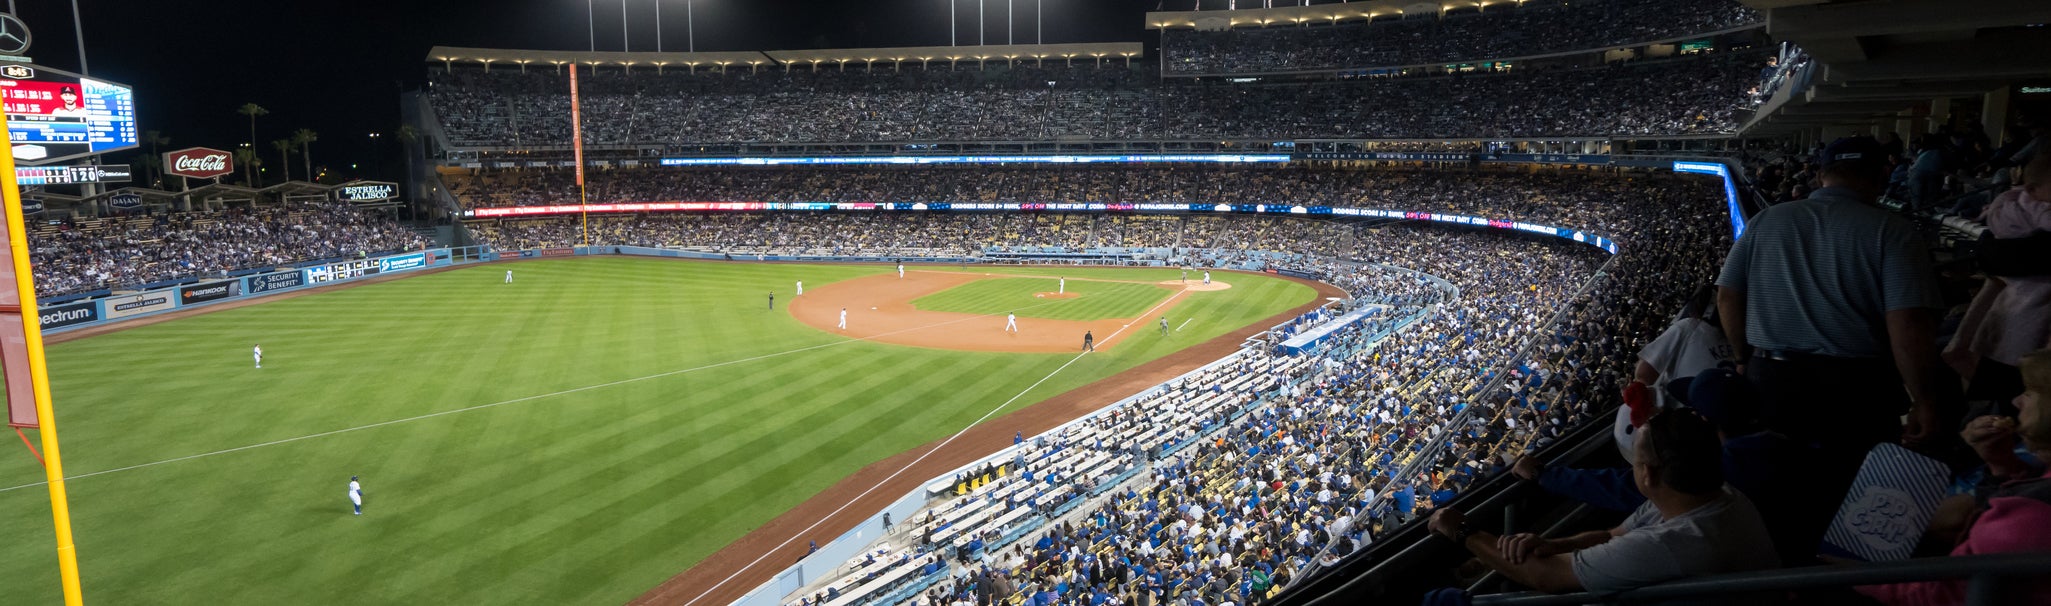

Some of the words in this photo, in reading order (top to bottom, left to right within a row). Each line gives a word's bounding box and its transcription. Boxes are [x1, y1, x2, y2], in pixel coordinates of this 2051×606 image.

[8, 68, 27, 77] 8:45
[175, 155, 227, 171] Coca-Cola
[72, 172, 77, 181] 1
[80, 172, 87, 181] 2
[89, 172, 95, 181] 0
[345, 184, 392, 195] ESTRELLA
[350, 191, 388, 200] JALISCO
[113, 196, 140, 206] DASANI
[1518, 222, 1557, 234] PAPAJOHNS.COM
[267, 272, 299, 282] SECURITY
[268, 280, 298, 290] BENEFIT
[38, 308, 89, 326] pectrum
